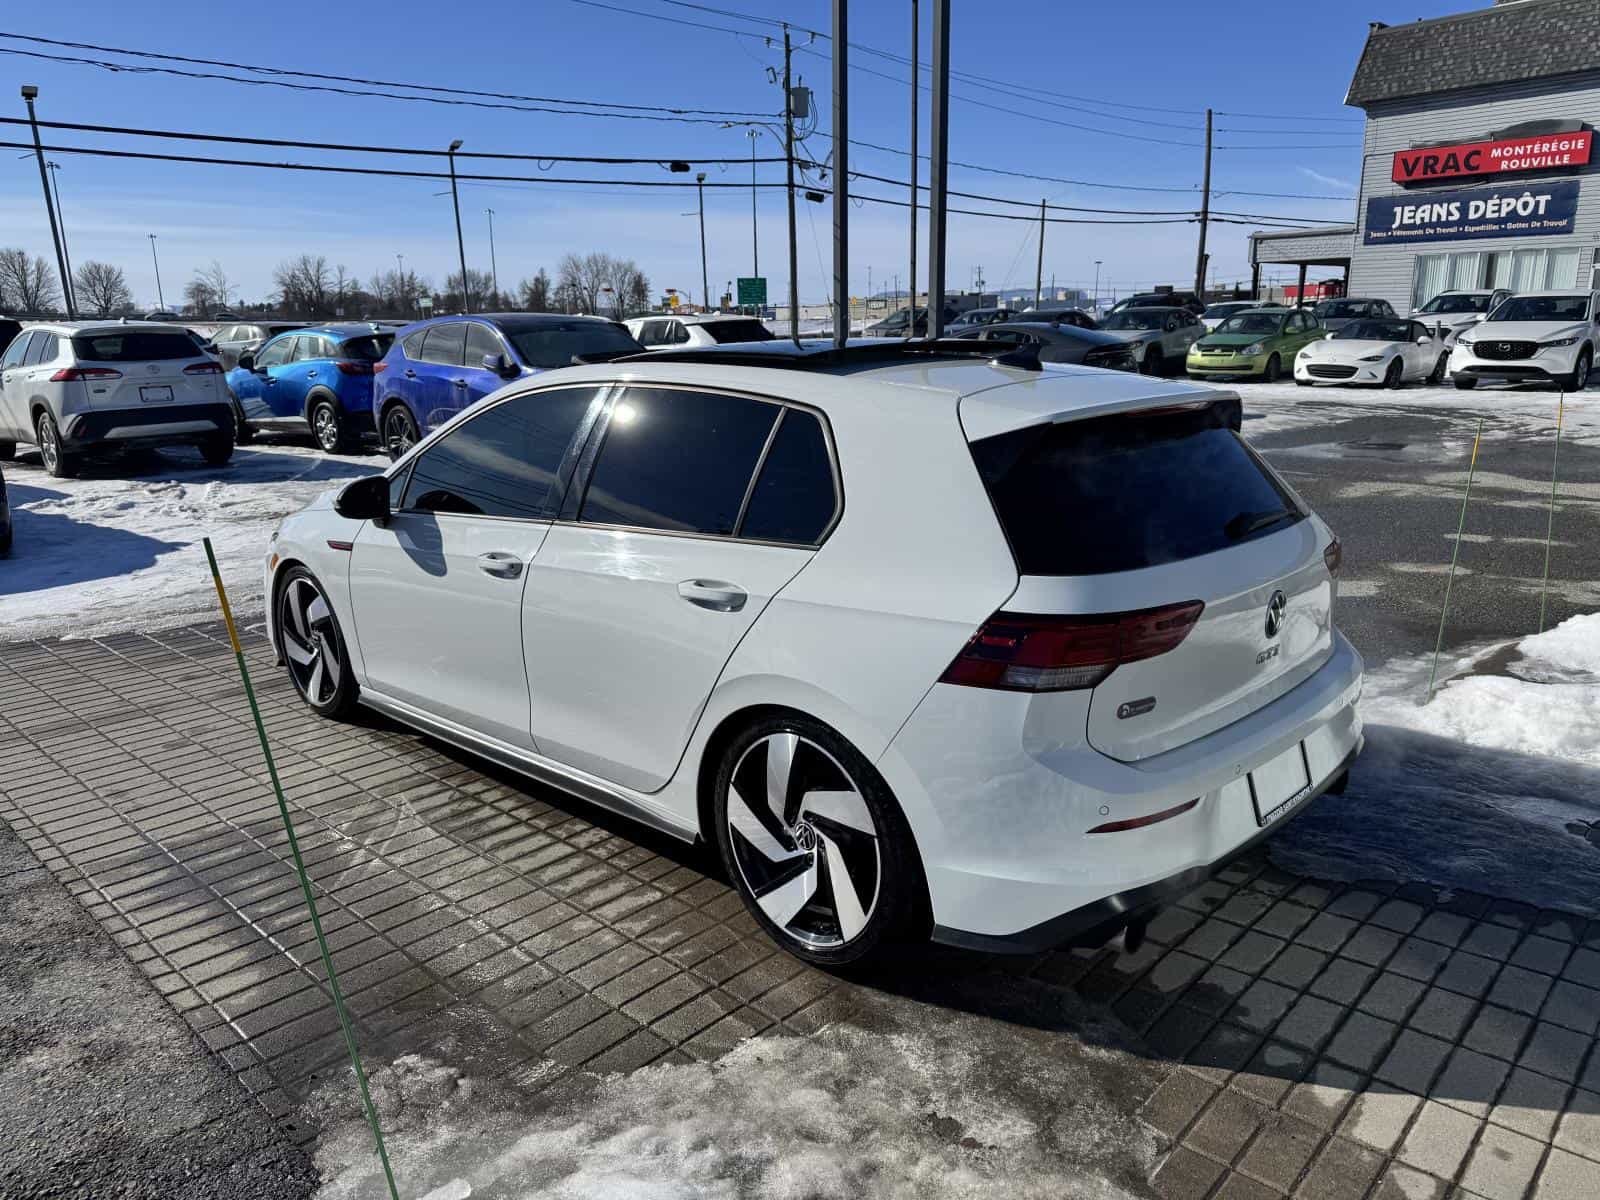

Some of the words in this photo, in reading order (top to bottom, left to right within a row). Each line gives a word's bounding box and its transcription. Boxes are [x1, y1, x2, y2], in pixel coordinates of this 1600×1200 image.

[1490, 139, 1586, 159] MONTÉRÉGIE
[1401, 150, 1482, 177] VRAC
[1500, 154, 1571, 170] ROUVILLE
[1391, 202, 1461, 229] JEANS
[1467, 192, 1552, 220] DÉPÔT
